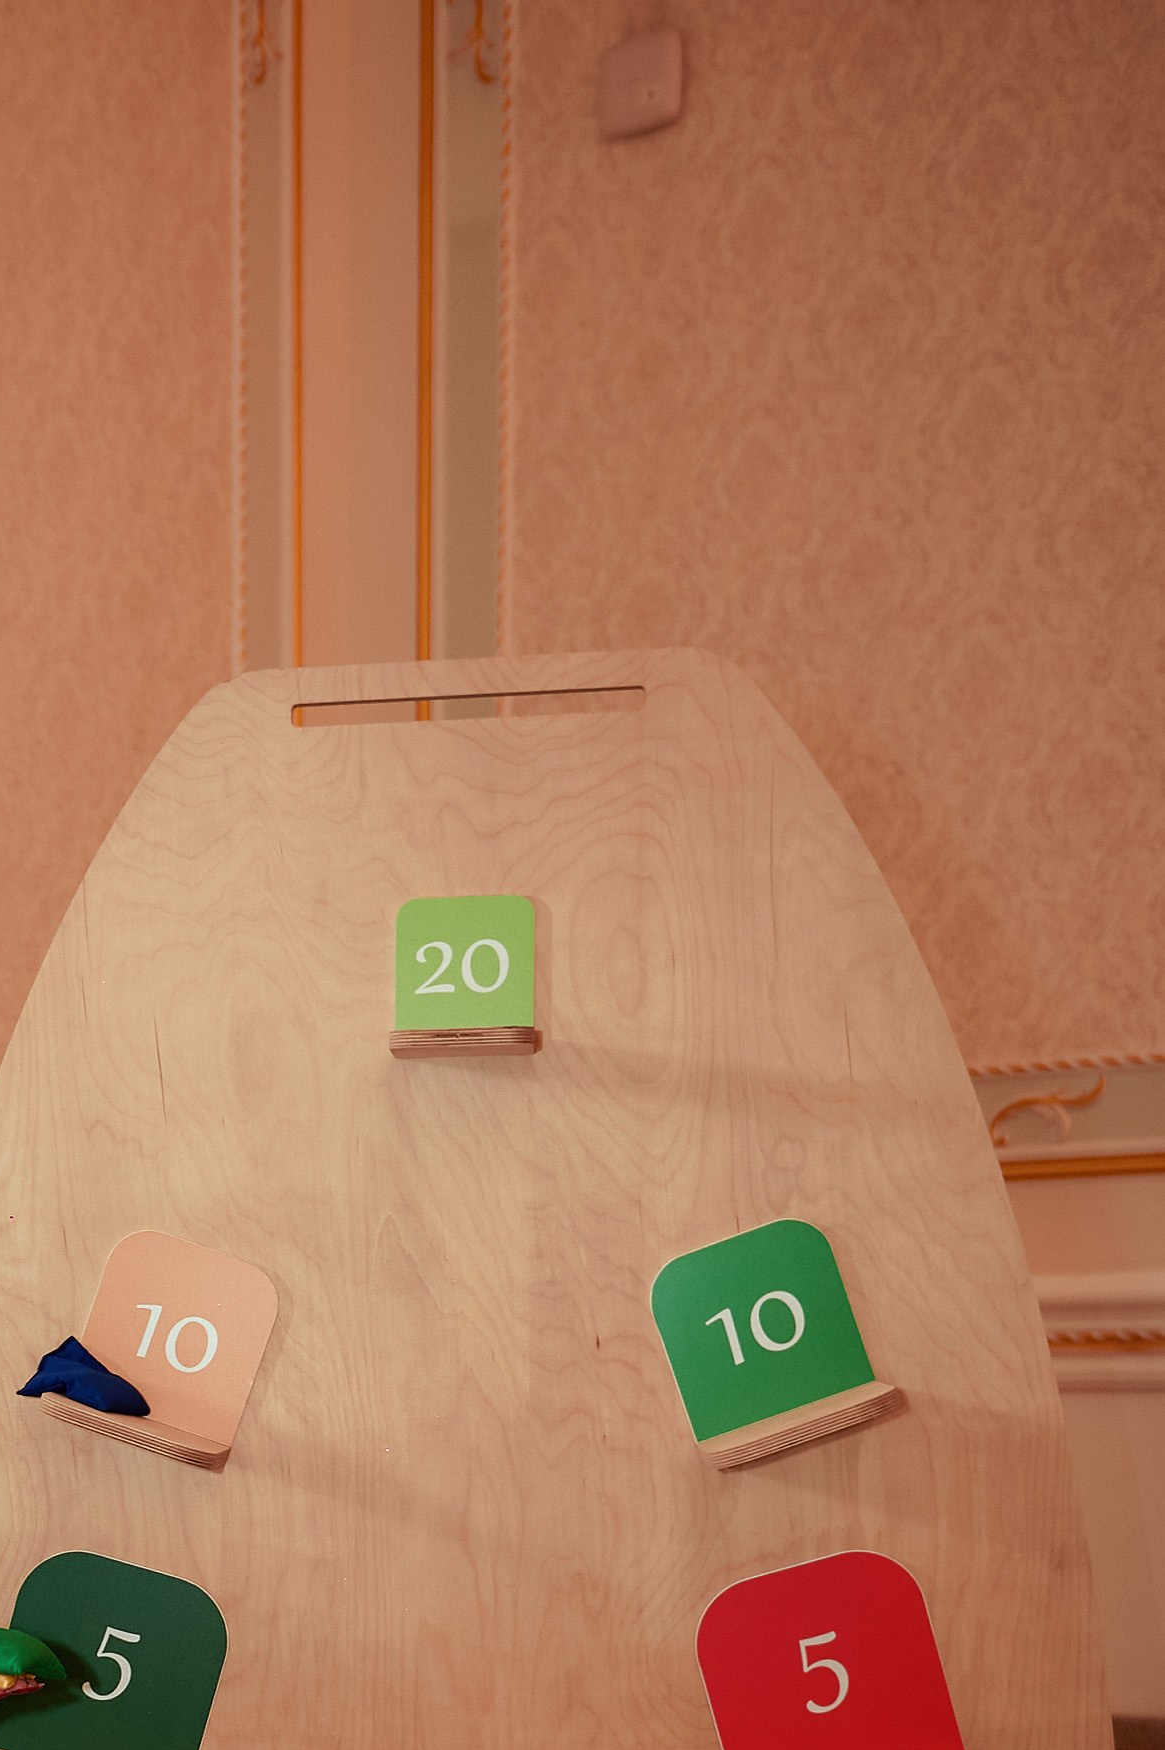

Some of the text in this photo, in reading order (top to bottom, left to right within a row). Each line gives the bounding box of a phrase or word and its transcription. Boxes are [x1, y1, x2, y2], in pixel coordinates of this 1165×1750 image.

[415, 938, 511, 995] 20
[135, 1303, 219, 1373] 10
[705, 1289, 807, 1367] 10
[82, 1625, 142, 1702] 5
[798, 1630, 851, 1715] 5
